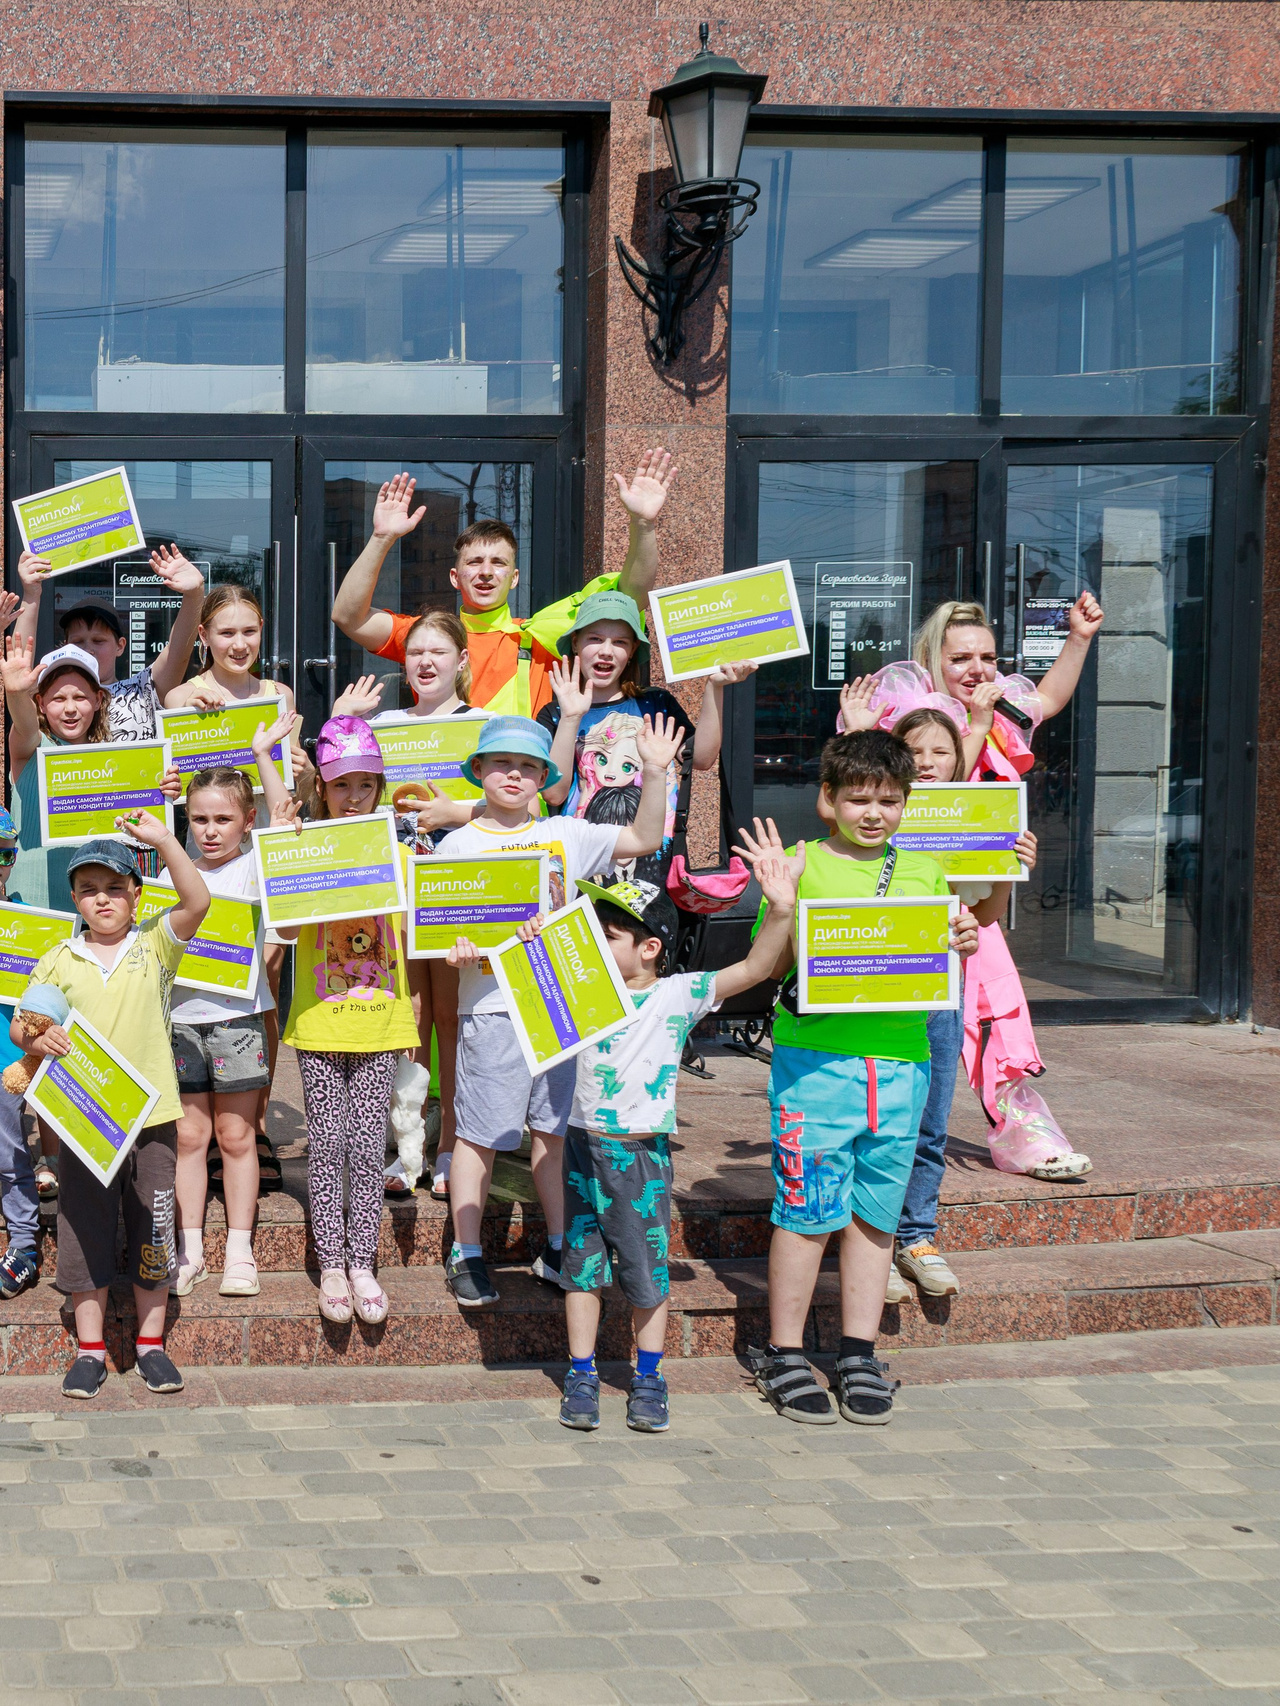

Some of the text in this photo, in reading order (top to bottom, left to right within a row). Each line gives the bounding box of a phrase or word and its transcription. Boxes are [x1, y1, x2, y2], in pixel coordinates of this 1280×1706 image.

[26, 502, 81, 528] ДИПЛОМ
[821, 574, 907, 587] Сормовские Зори
[666, 598, 733, 623] ДИПЛОМ
[671, 614, 779, 643] ВЫДАН САМОМУ ТАЛАНТЛИВОМУ
[672, 629, 739, 649] ЮНОМУ КОНДИТЕРУ
[51, 767, 113, 783] ДИПЛОМ
[103, 792, 152, 801] ТАЛАНТЛИВОМУ
[77, 801, 114, 810] КОНДИТЕРУ
[501, 840, 540, 851] FUTURE
[265, 844, 334, 864] ДИПЛОМ
[269, 868, 380, 887] ВЫДАН САМОМУ ТАЛАНТЛИВОМУ
[270, 879, 339, 893] ЮНОМУ КОНДИТЕРУ
[419, 879, 485, 893] ДИПЛОМ
[419, 909, 443, 917] ВЫДАН
[473, 906, 525, 914] ТАЛАНТЛИВОМУ
[446, 914, 485, 922] КОНДИТЕРУ
[813, 926, 887, 941] ДИПЛОМ
[554, 921, 588, 984] ДИПЛОМ
[813, 959, 840, 967] ВЫДАН
[813, 965, 887, 974] ЮНОМУ КОНДИТЕРУ
[525, 941, 552, 1001] ЮНОМУ КОНДИТЕРУ
[531, 937, 573, 1034] ВЫДАН САМОМУ ТАЛАНТЛИВОМУ
[332, 1004, 345, 1014] of
[350, 1003, 366, 1012] the
[232, 1034, 249, 1047] Where
[237, 1035, 256, 1055] are you?
[780, 1105, 806, 1206] HEAT
